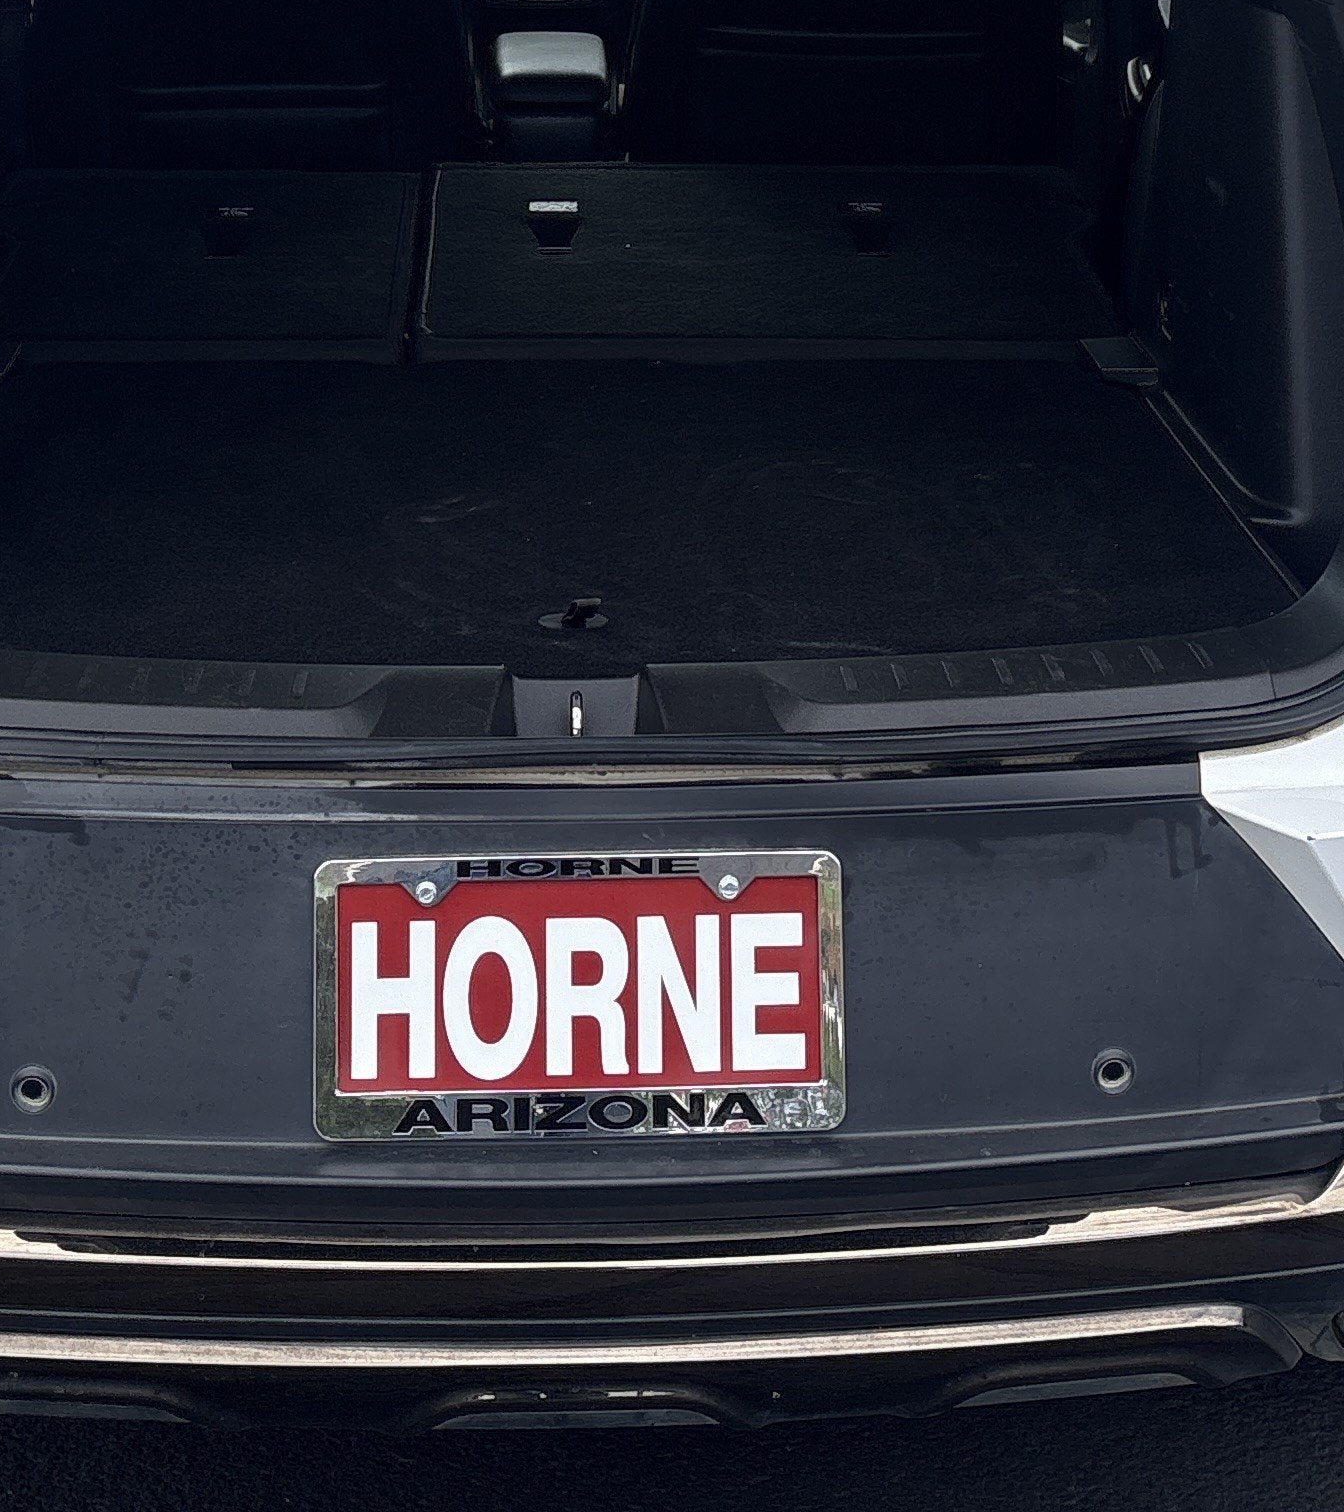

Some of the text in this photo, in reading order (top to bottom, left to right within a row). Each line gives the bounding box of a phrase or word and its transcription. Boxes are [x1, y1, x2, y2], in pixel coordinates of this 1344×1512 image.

[457, 858, 700, 878] HORNE
[350, 913, 807, 1081] HORNE
[393, 1094, 768, 1135] ARIZONA
